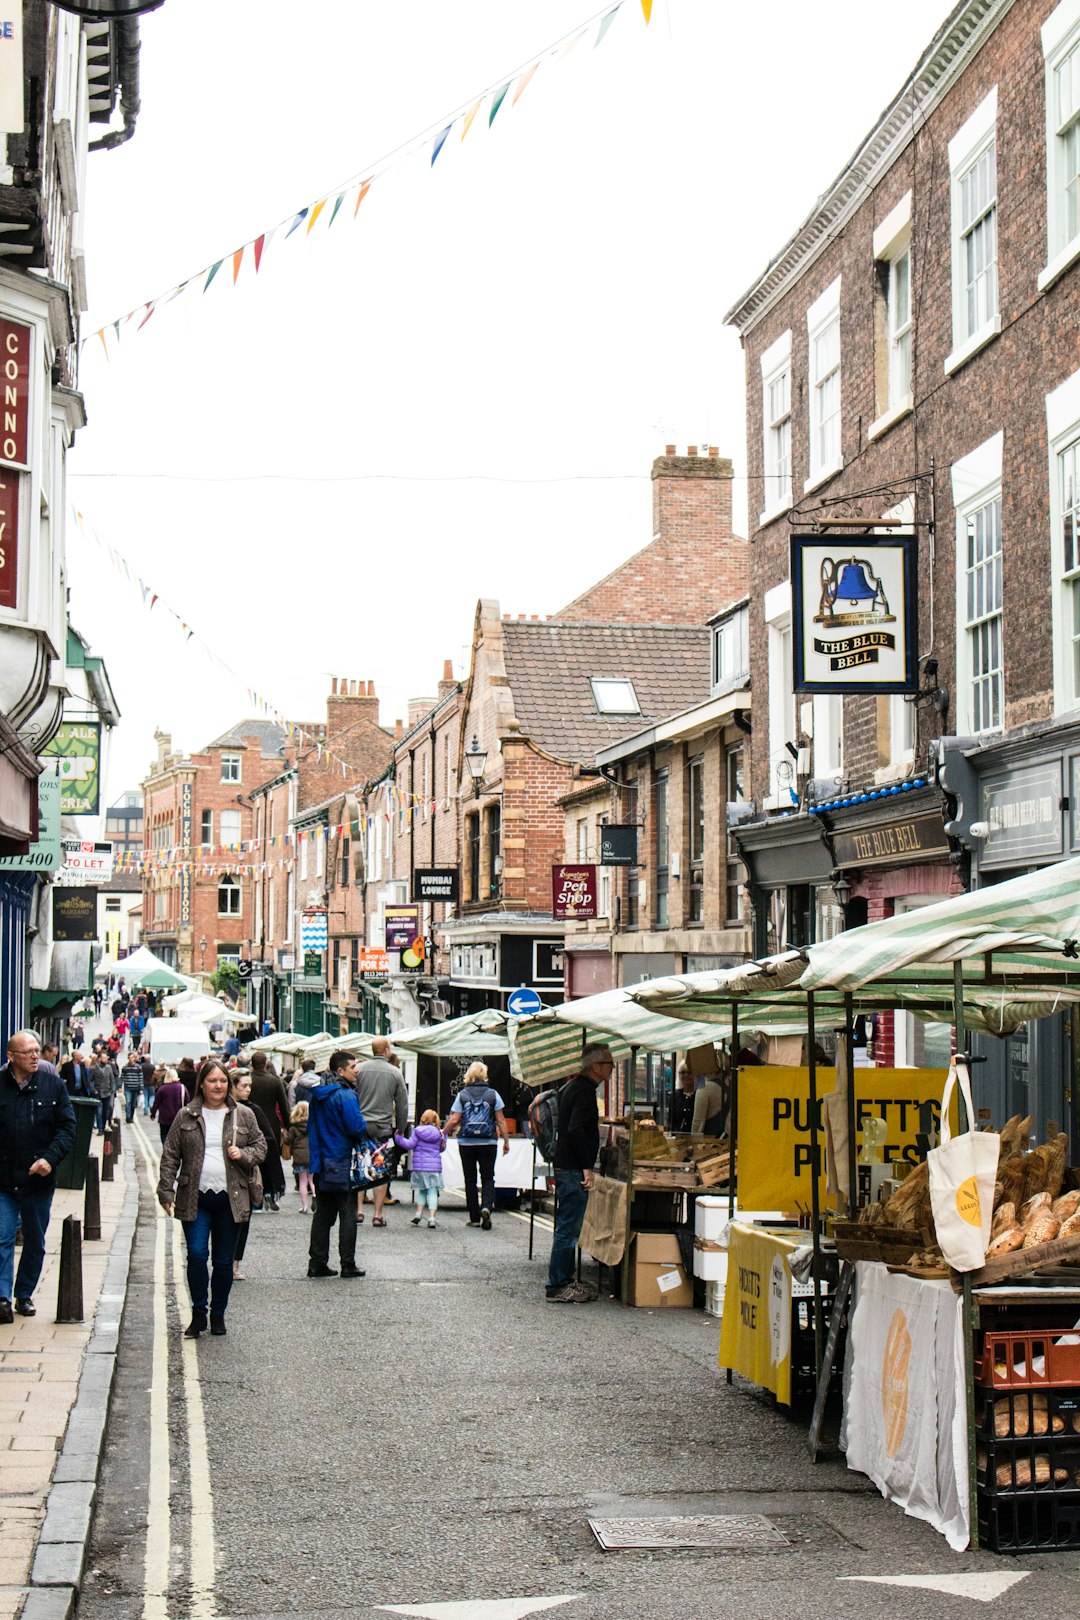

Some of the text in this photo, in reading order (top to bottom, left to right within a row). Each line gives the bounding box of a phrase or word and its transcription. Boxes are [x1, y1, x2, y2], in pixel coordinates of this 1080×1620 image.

[4, 333, 19, 459] CONNO
[821, 634, 888, 653] THE BLUE
[837, 652, 872, 669] BELL
[69, 727, 97, 739] ALE
[183, 784, 191, 817] LOCH
[853, 825, 921, 858] THE BLUE BELL
[66, 858, 104, 869] TO LET
[421, 876, 452, 885] MUMBAI
[562, 881, 588, 892] Pen
[421, 886, 451, 895] LOUNGE
[557, 892, 592, 906] Shop
[360, 961, 377, 970] FOR
